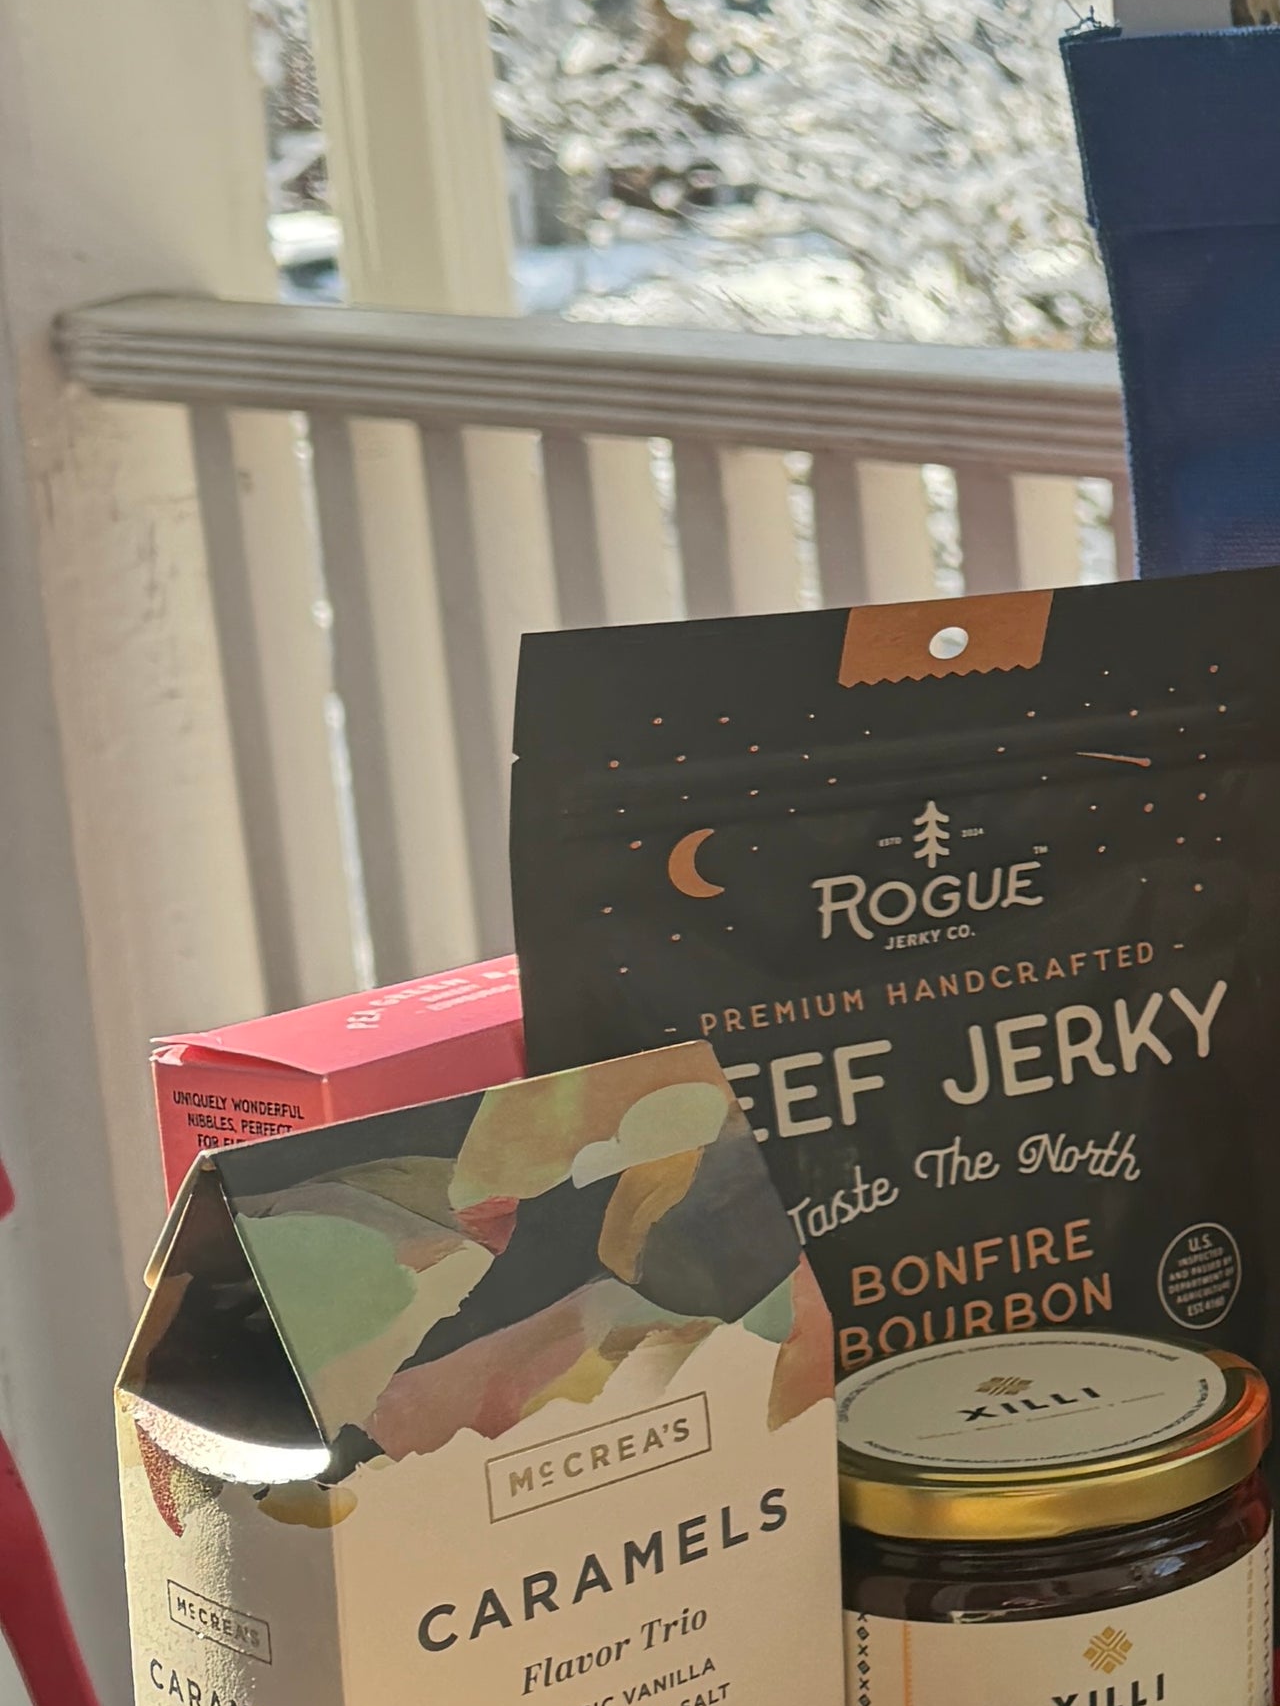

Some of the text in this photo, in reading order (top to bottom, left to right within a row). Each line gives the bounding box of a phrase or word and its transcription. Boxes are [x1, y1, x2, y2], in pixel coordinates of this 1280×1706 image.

[811, 861, 1044, 941] ROGUE
[884, 924, 976, 951] JERKY CO.
[700, 941, 1155, 1036] PREMIUM HANDCRAFTED
[943, 979, 1228, 1106] JERKY
[173, 1090, 305, 1119] UNIQUELY WONDERFUL
[787, 1130, 1142, 1246] Taste The North
[852, 1218, 1094, 1308] BONFIRE
[838, 1272, 1113, 1371] BOURBON
[957, 1386, 1102, 1422] XILLI
[416, 1487, 790, 1654] CARAMELS
[521, 1606, 709, 1696] Flavor Trio
[622, 1657, 716, 1706] VANILLA
